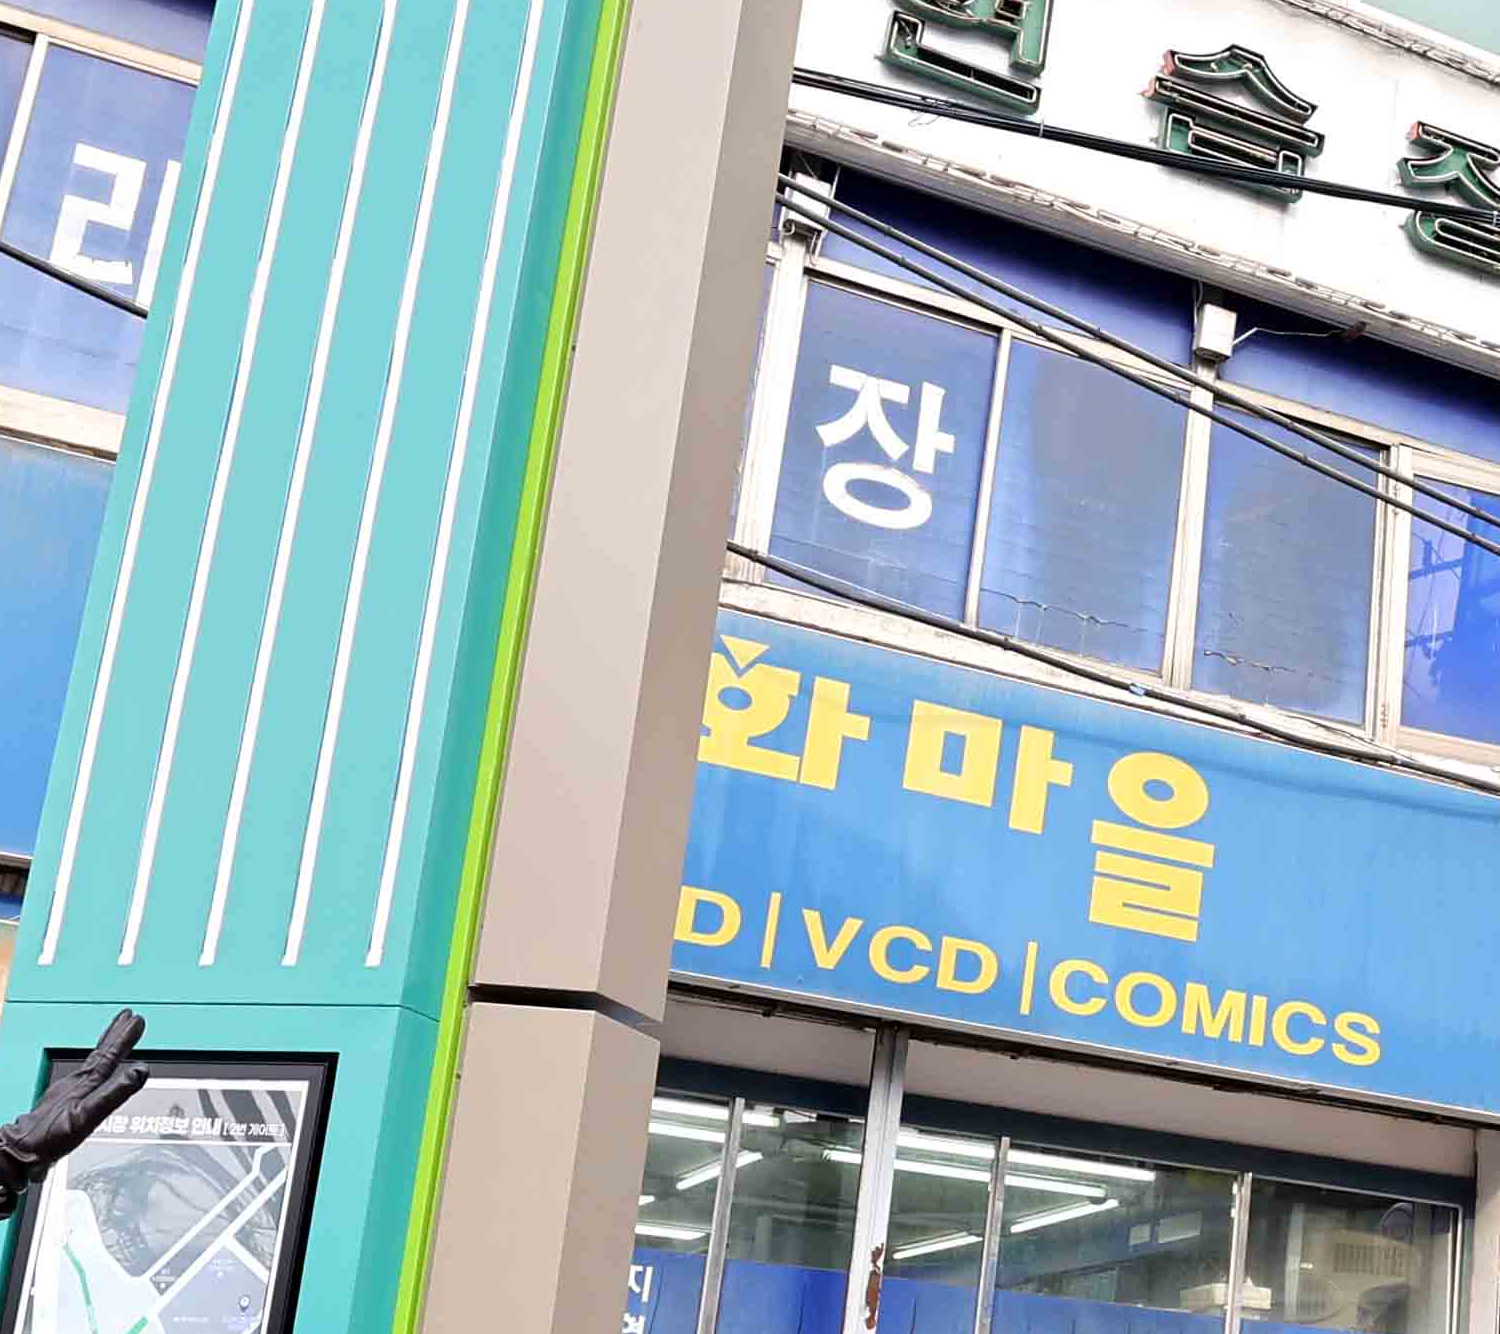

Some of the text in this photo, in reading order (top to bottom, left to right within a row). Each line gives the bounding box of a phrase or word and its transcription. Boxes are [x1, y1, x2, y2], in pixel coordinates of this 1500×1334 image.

[815, 364, 956, 530] 장
[697, 633, 1217, 943] 화마을
[802, 908, 999, 995] VCD
[1048, 959, 1382, 1067] COMICS
